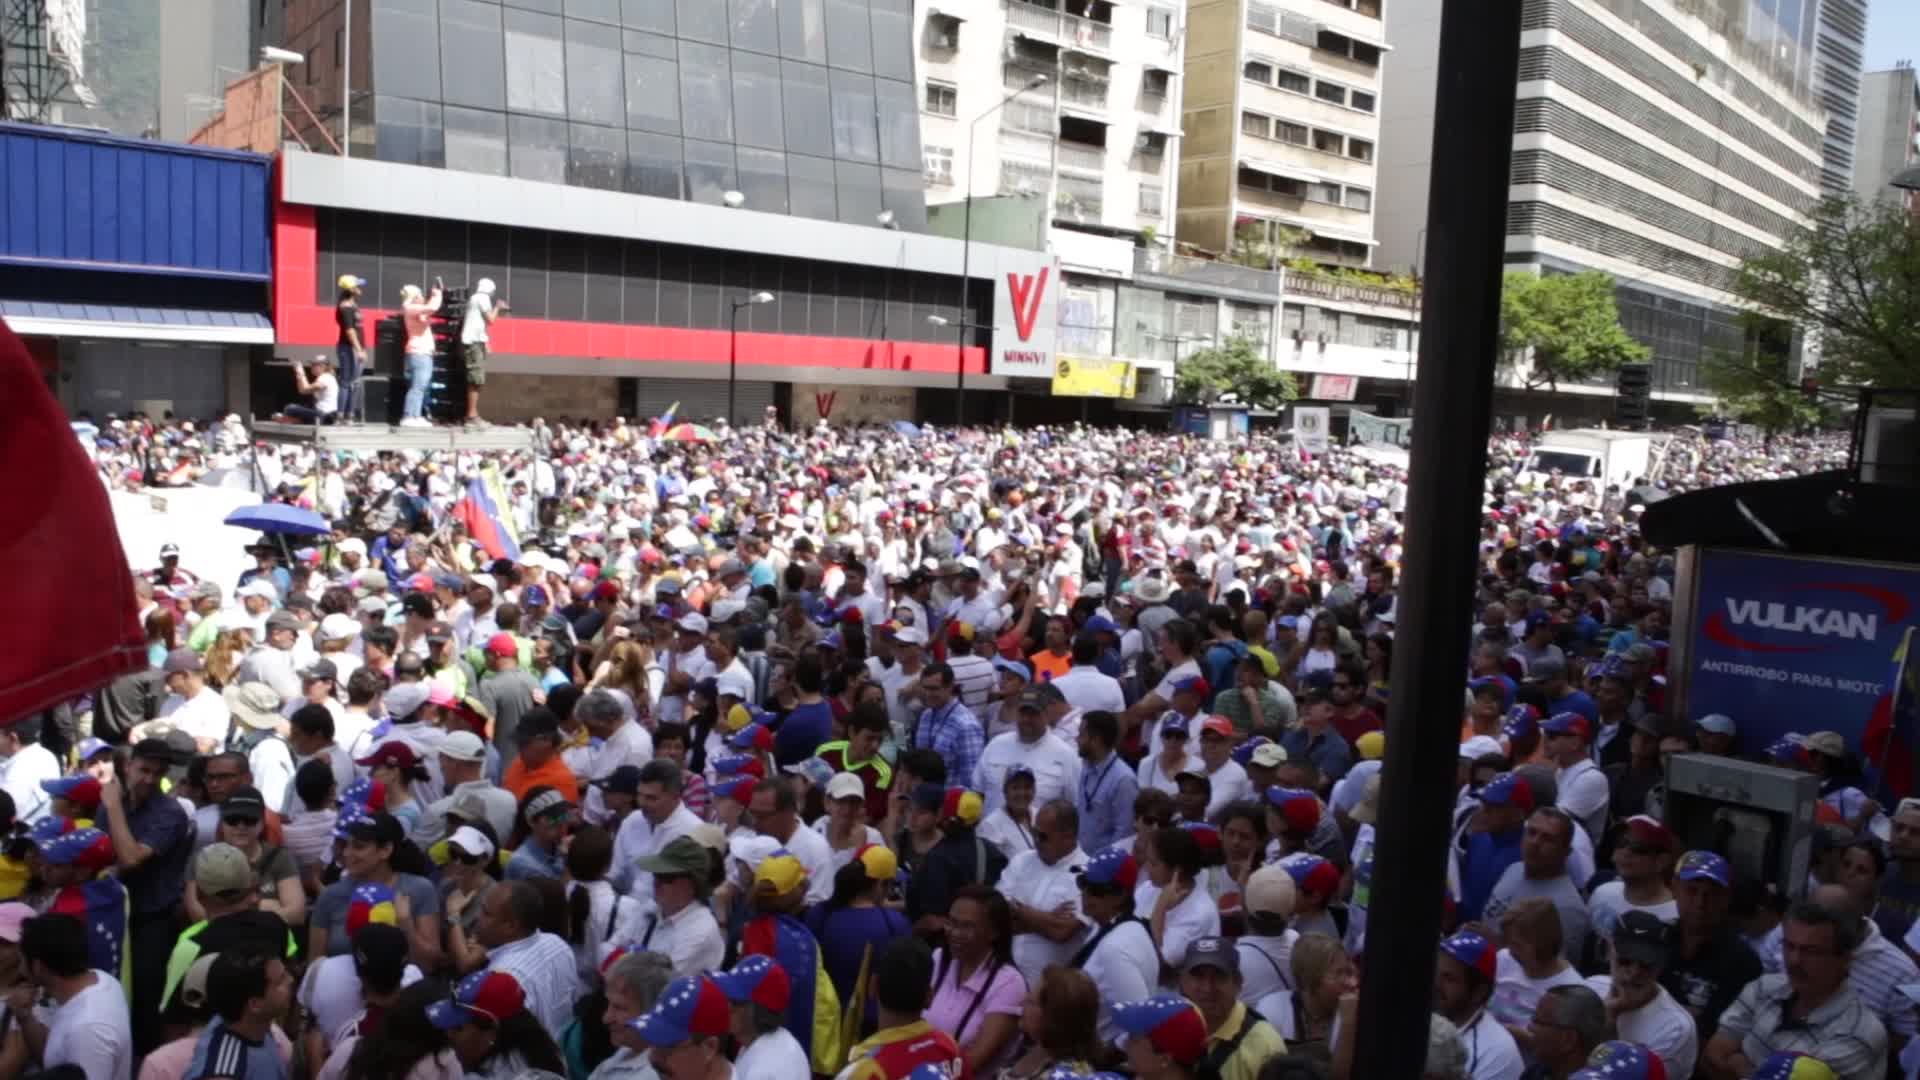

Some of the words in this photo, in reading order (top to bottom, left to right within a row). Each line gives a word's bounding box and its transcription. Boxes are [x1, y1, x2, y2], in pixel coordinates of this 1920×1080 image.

[1725, 597, 1877, 640] VULKAN
[1701, 659, 1788, 681] ANTIRROBO
[1792, 672, 1833, 688] PARA
